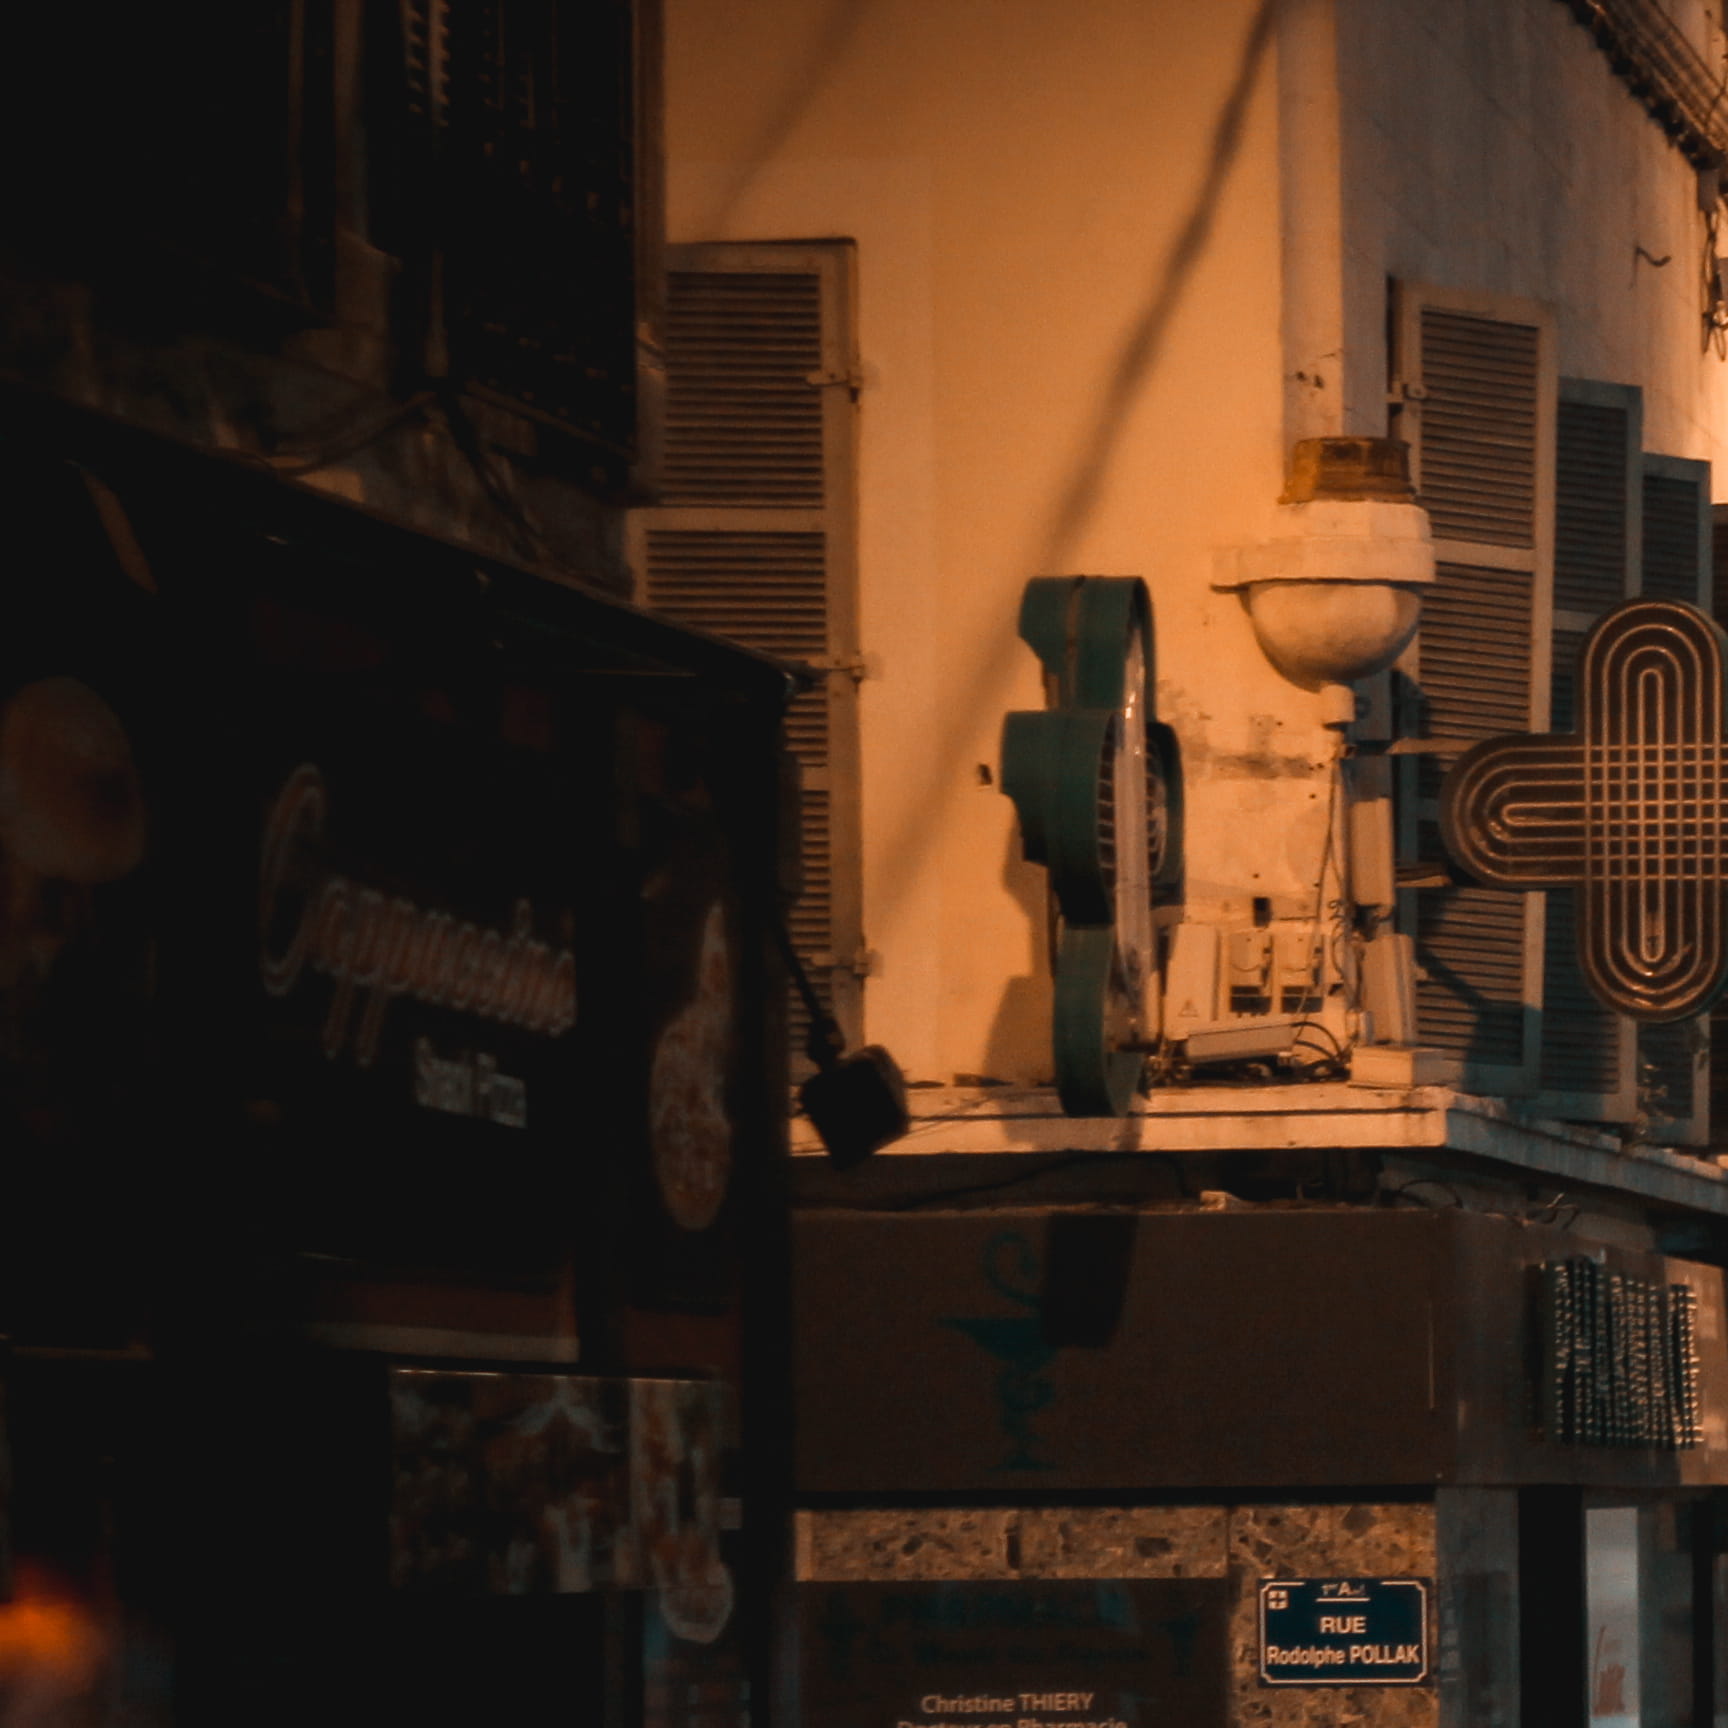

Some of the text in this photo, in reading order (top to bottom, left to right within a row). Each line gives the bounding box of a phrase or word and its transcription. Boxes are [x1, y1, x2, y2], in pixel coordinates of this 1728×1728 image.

[1318, 1615, 1368, 1635] RUE
[1266, 1644, 1421, 1669] Rodolphe POLLAK
[920, 1692, 1095, 1714] Christine THIERY
